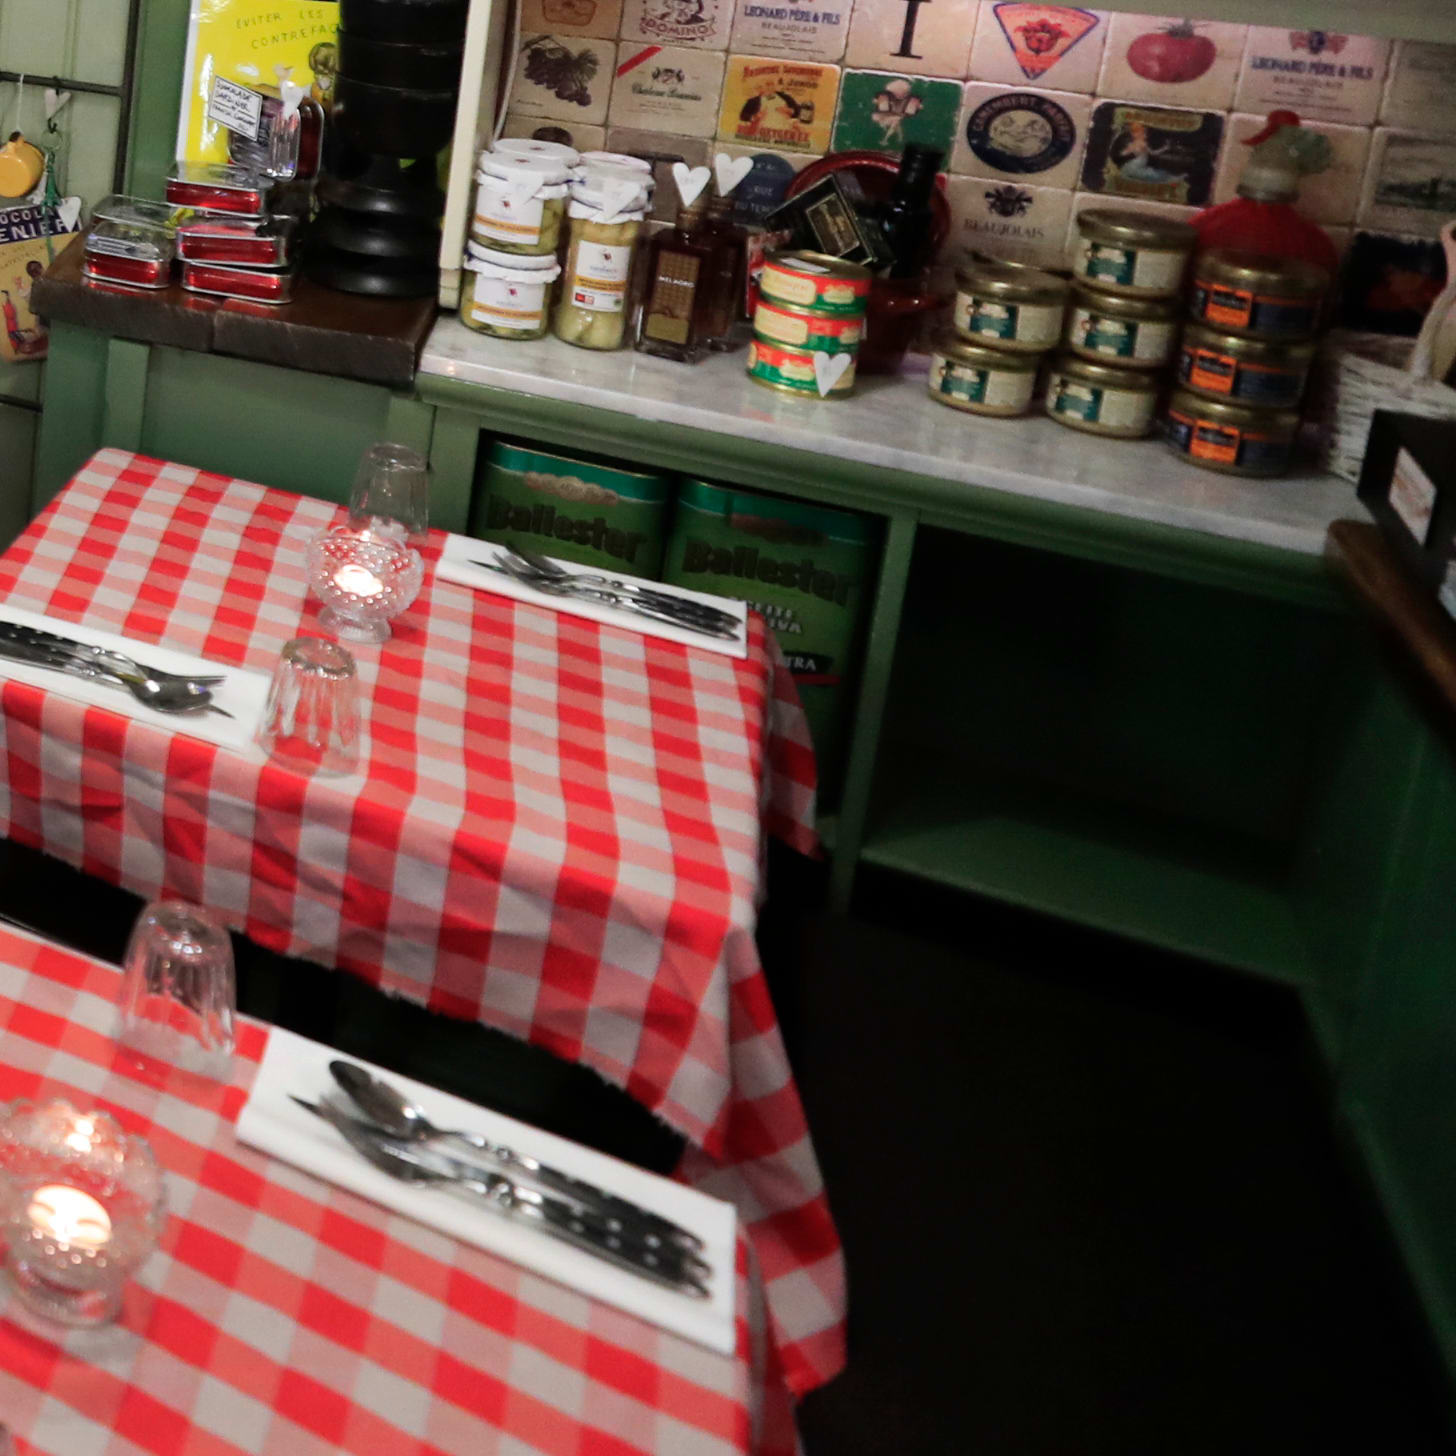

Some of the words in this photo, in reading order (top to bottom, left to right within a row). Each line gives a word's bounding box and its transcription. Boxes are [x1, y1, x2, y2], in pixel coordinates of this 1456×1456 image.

[744, 5, 787, 18] LEONARD
[822, 13, 840, 25] FILS
[645, 18, 709, 37] DOMINO
[683, 540, 856, 606] Ballester
